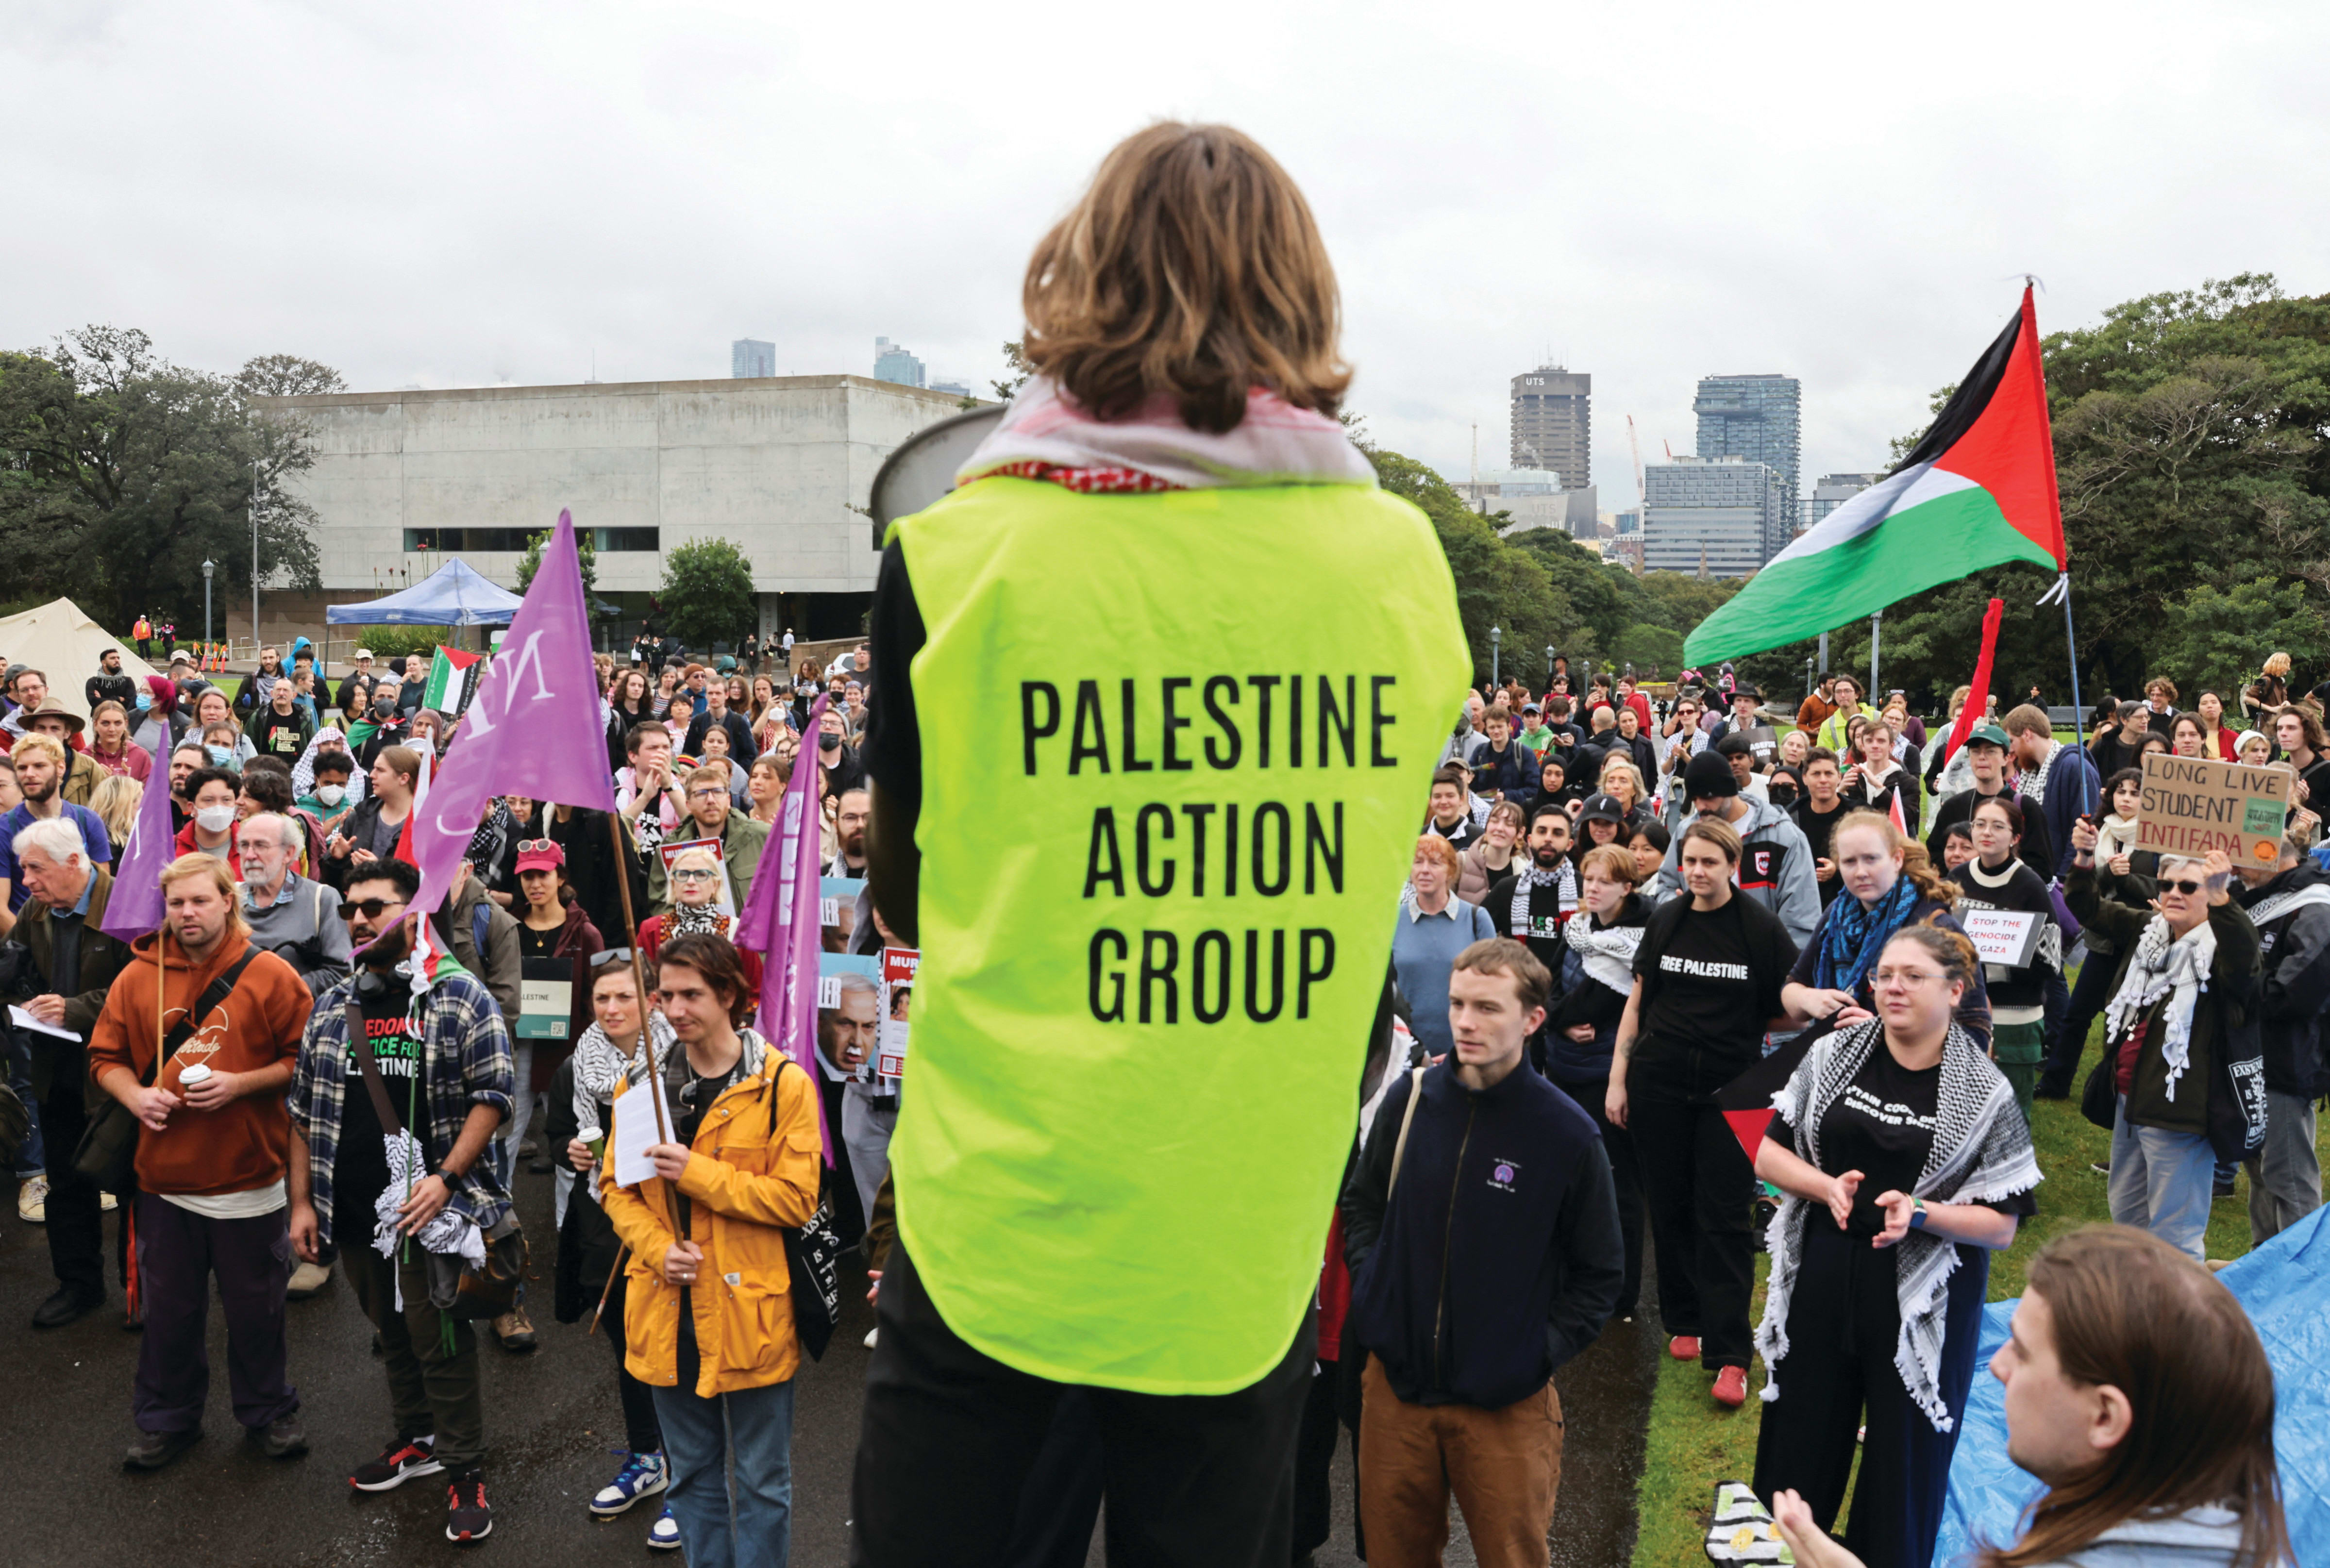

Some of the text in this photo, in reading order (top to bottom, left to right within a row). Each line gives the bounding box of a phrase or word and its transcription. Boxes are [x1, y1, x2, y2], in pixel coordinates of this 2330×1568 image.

[1525, 377, 1544, 386] UTS
[462, 662, 477, 711] REVOLUTION
[1021, 675, 1397, 775] PALESTINE
[1750, 741, 1776, 751] ASEFIRE
[2147, 759, 2279, 794] LONG LIVE
[2142, 787, 2239, 823] STUDENT
[1083, 802, 1343, 898] ACTION
[2137, 820, 2242, 858] INTIFADA
[1968, 931, 2018, 941] GENOCIDE
[890, 955, 919, 968] MUR
[1980, 945, 2006, 953] GAZA
[1089, 929, 1335, 1024] GROUP
[1659, 955, 1748, 980] FREE PALESTINE
[365, 1017, 415, 1037] EDOM
[2245, 1089, 2253, 1100] IS
[1844, 1097, 1903, 1125] DISCOVER
[813, 1249, 823, 1263] IS
